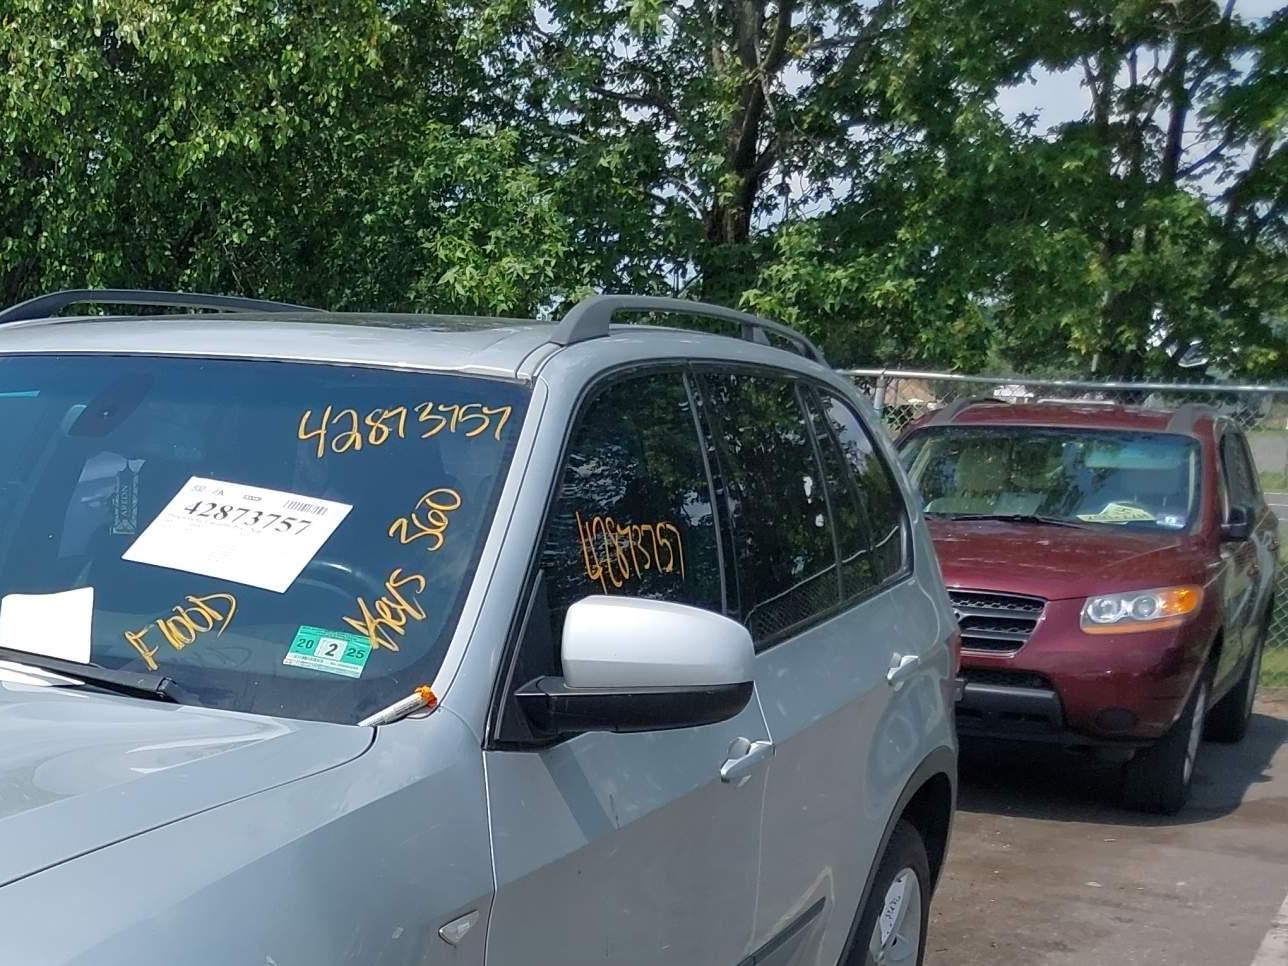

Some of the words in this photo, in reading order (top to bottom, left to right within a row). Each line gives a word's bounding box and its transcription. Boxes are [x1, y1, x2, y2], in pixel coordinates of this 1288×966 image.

[297, 402, 512, 459] 42873757
[184, 500, 312, 536] 42873757
[296, 638, 314, 649] 20
[324, 643, 338, 657] 2
[346, 648, 366, 659] 25
